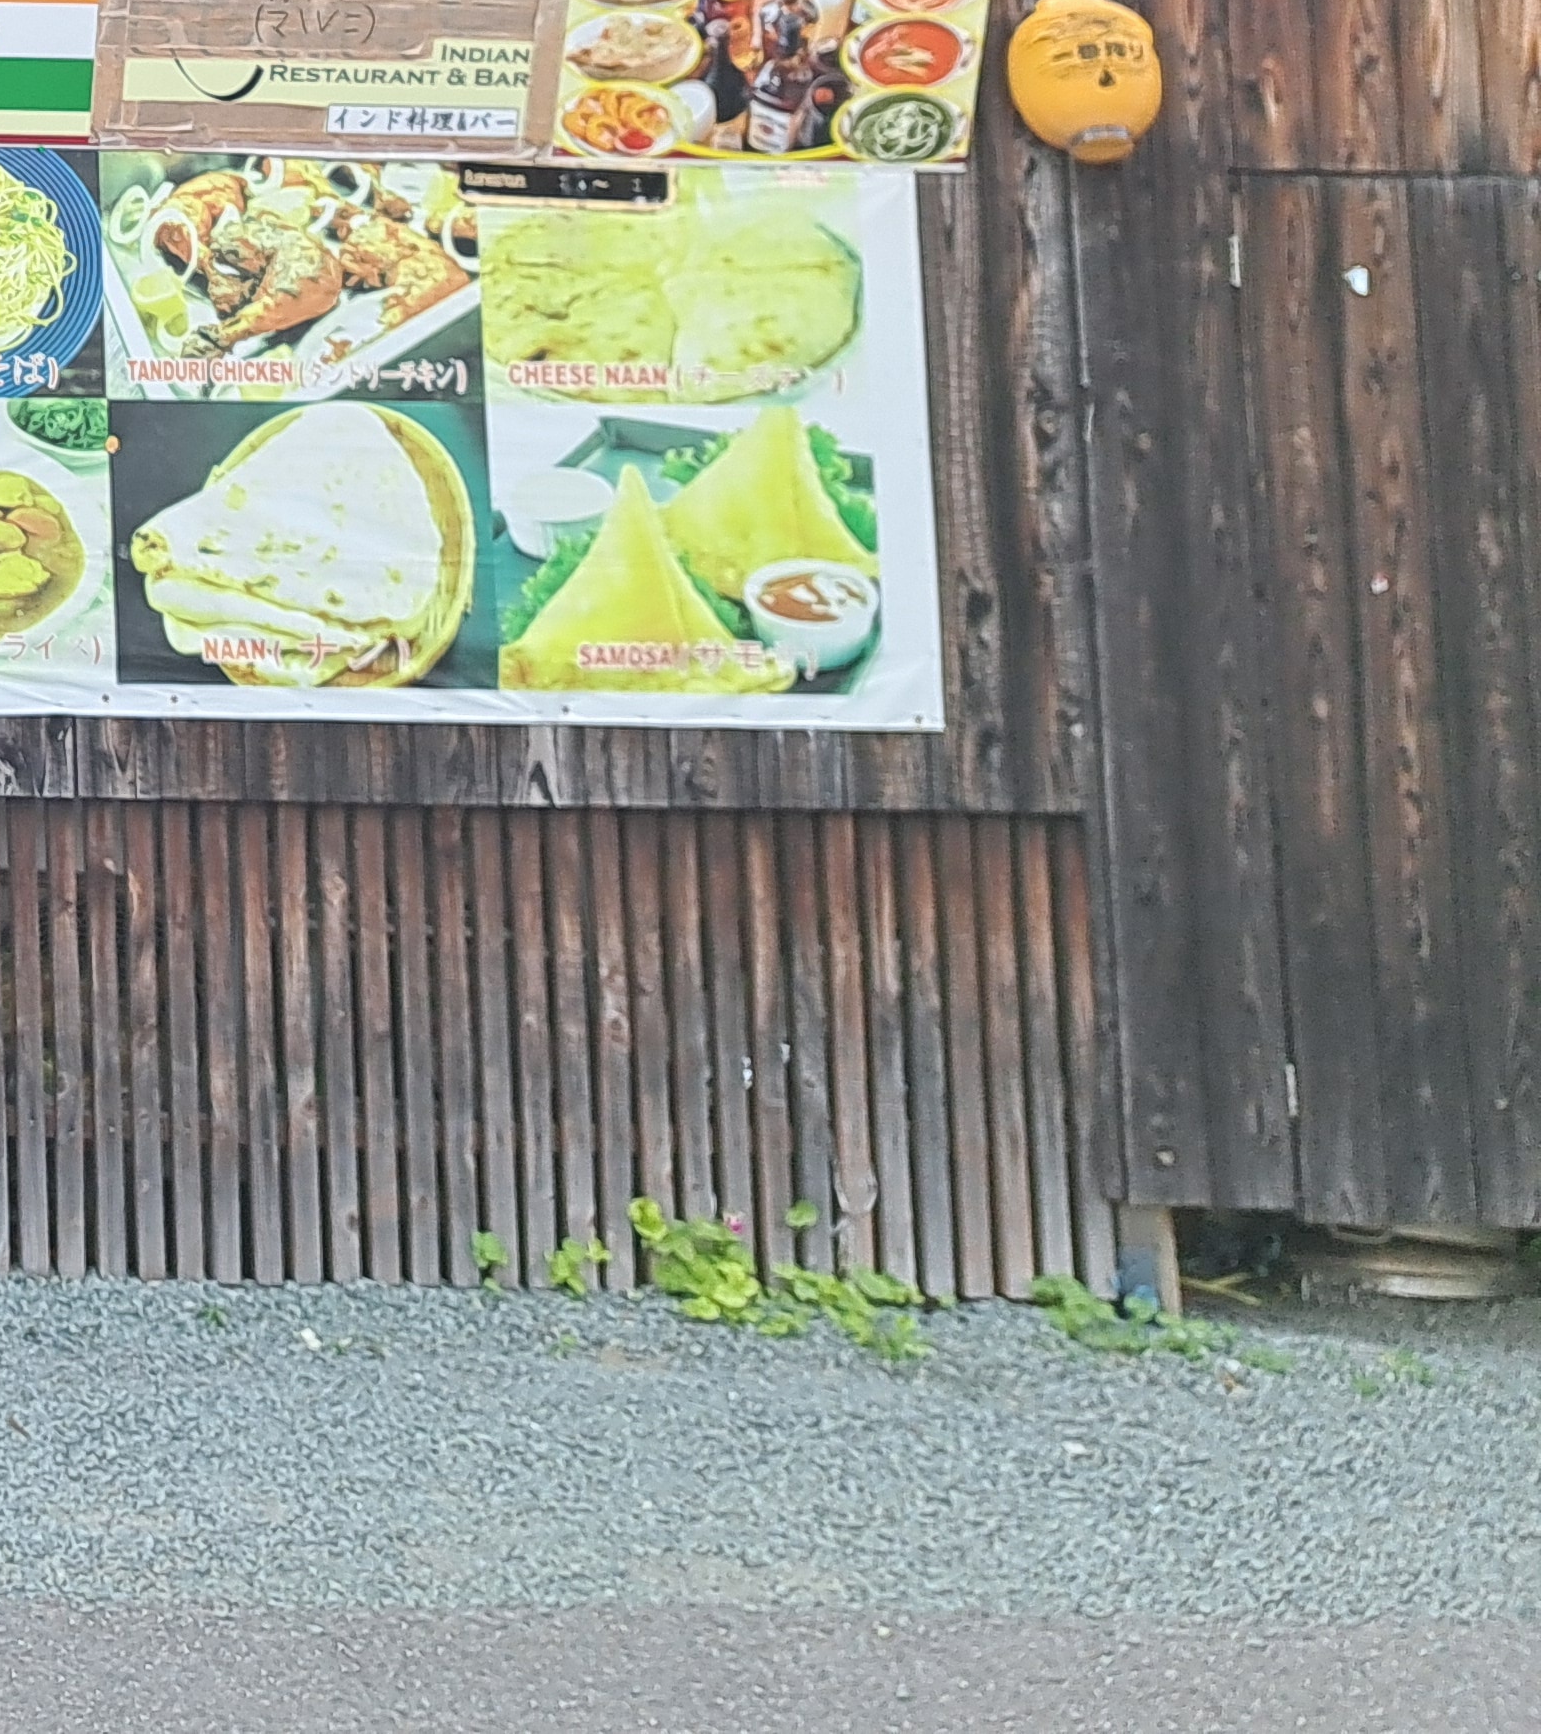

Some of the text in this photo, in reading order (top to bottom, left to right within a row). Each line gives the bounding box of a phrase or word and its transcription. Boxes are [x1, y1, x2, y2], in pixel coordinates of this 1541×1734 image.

[446, 69, 466, 86] &
[126, 359, 209, 383] TANDURI
[211, 360, 294, 385] CHICKEN
[507, 363, 598, 388] CHEESE
[604, 364, 669, 388] NAAN
[204, 637, 266, 662] NAAN
[578, 642, 673, 668] SAMOSA
